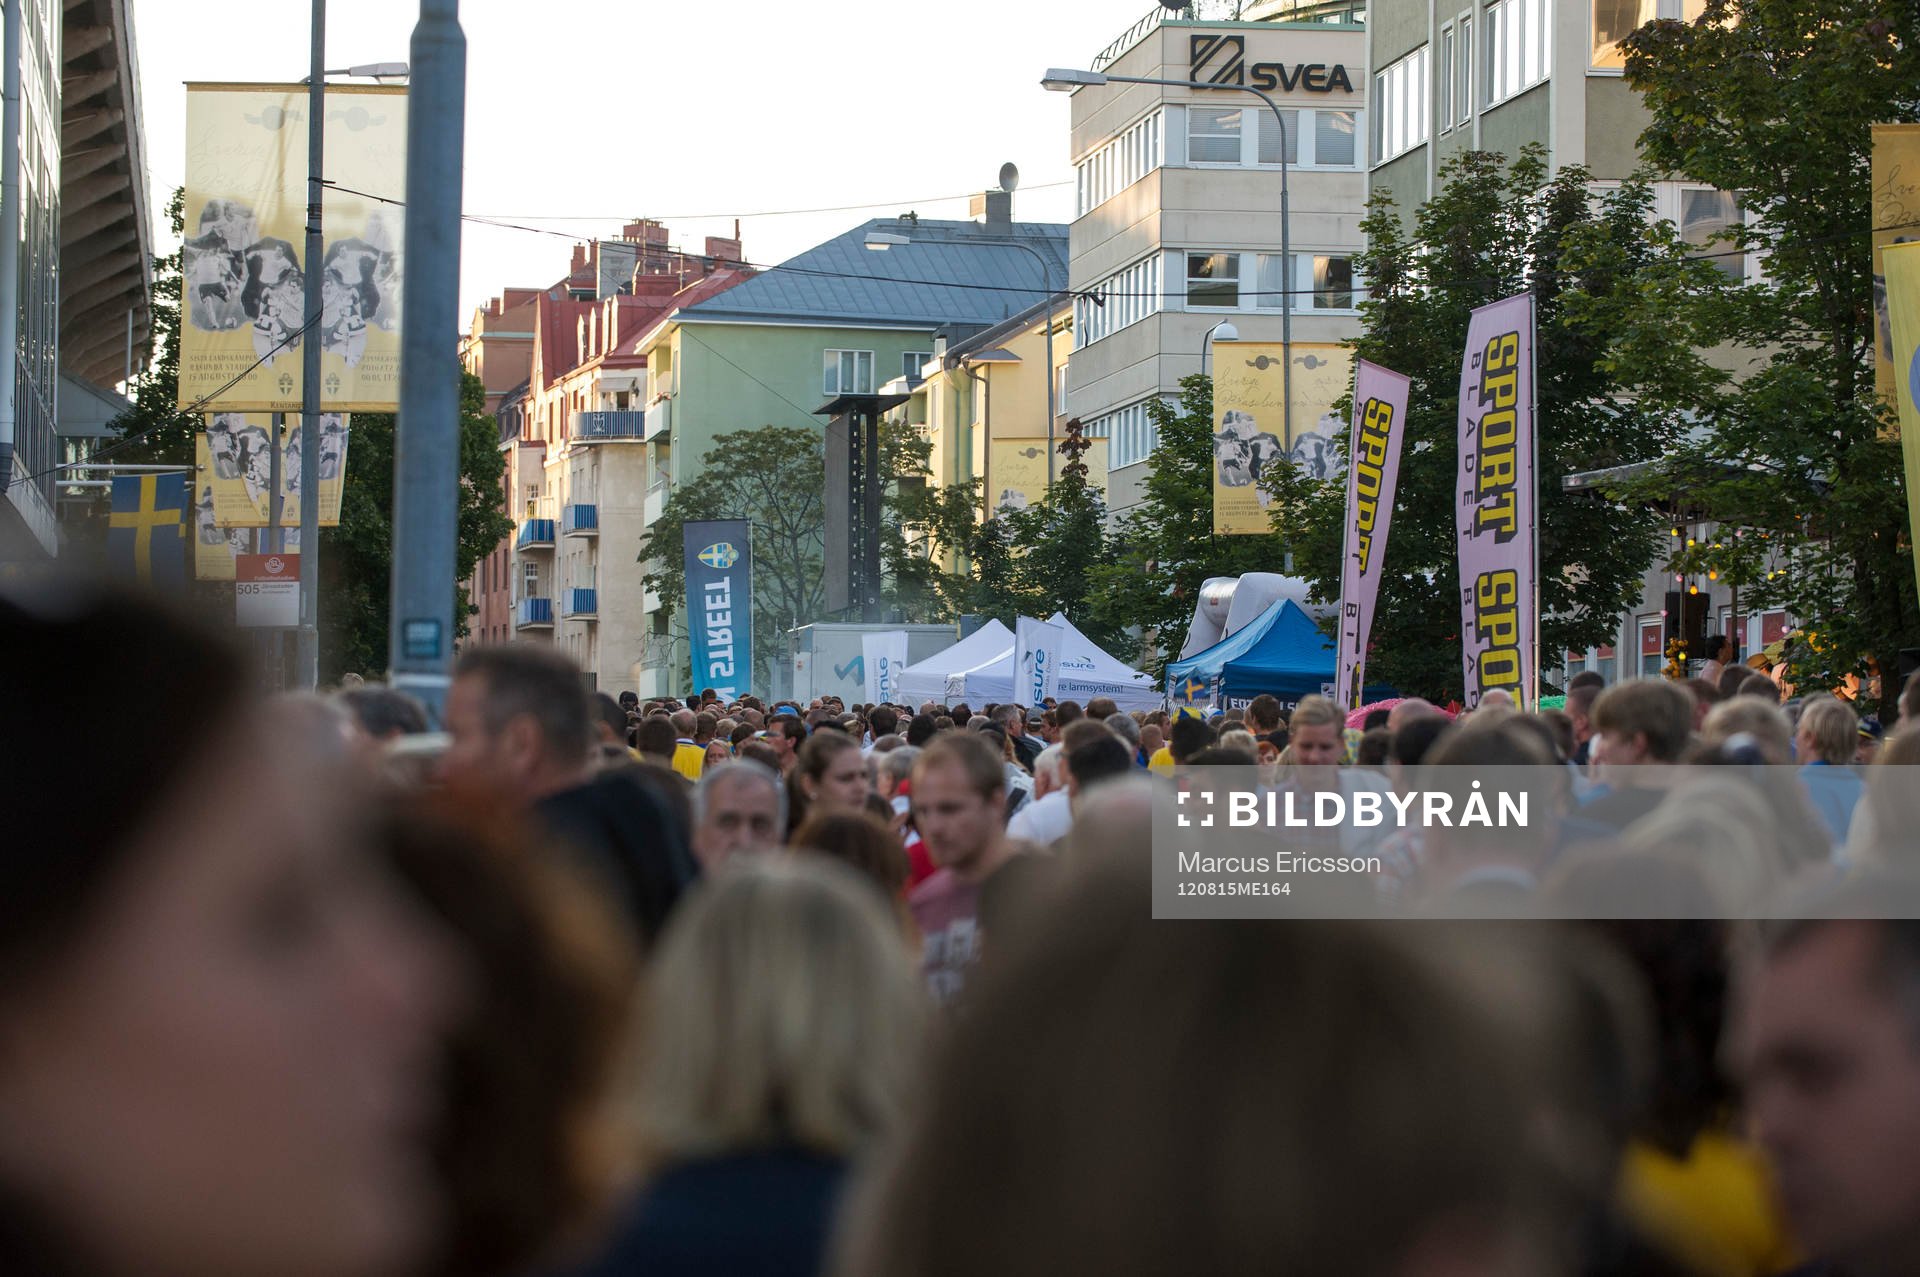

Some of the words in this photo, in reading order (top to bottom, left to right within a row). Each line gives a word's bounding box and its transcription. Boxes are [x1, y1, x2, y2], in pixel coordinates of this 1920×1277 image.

[1251, 62, 1353, 93] SVEA
[1463, 351, 1482, 541] BLADET
[1474, 330, 1520, 544] SPORT
[238, 584, 260, 595] 505
[1060, 661, 1096, 670] sure
[1463, 587, 1479, 709] BLAD
[1474, 568, 1523, 711] SPO
[1034, 649, 1044, 702] sure
[1069, 681, 1123, 694] larmsystem!
